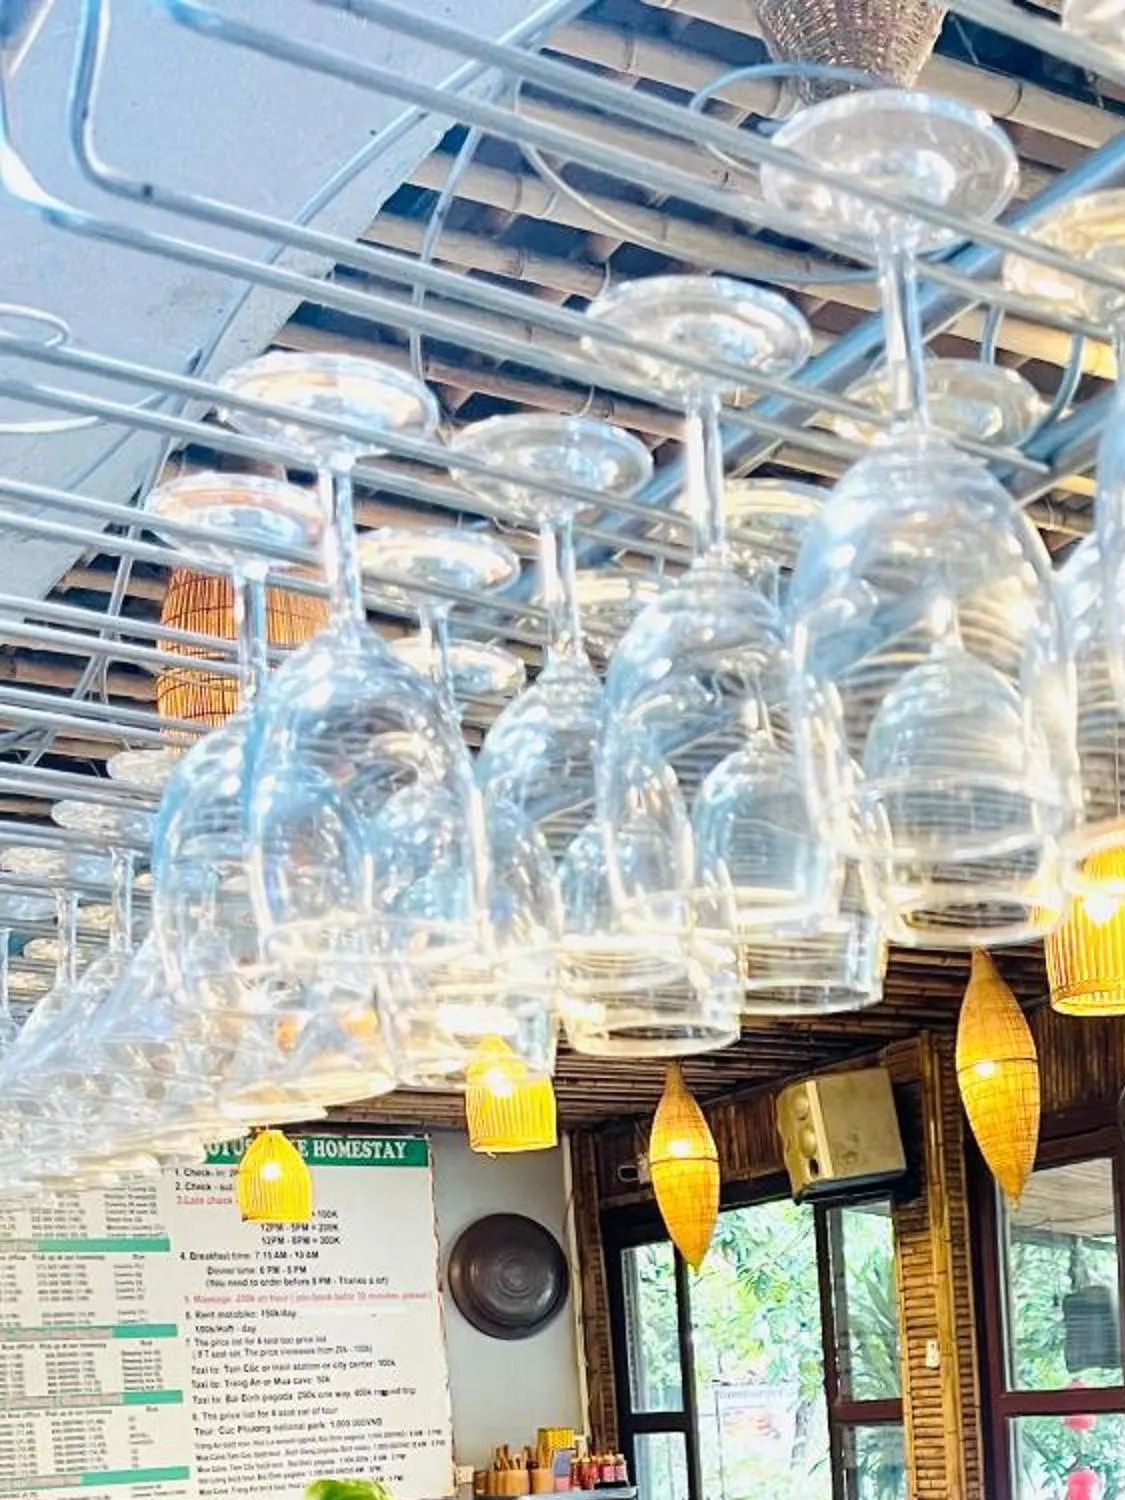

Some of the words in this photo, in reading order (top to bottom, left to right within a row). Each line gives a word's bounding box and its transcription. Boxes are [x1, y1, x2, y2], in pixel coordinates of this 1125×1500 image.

[203, 1139, 251, 1156] OTU
[314, 1141, 407, 1159] HOMESTAY
[185, 1181, 211, 1191] Check
[189, 1251, 229, 1260] Breakfast
[274, 1250, 287, 1258] AM
[306, 1250, 319, 1258] AM
